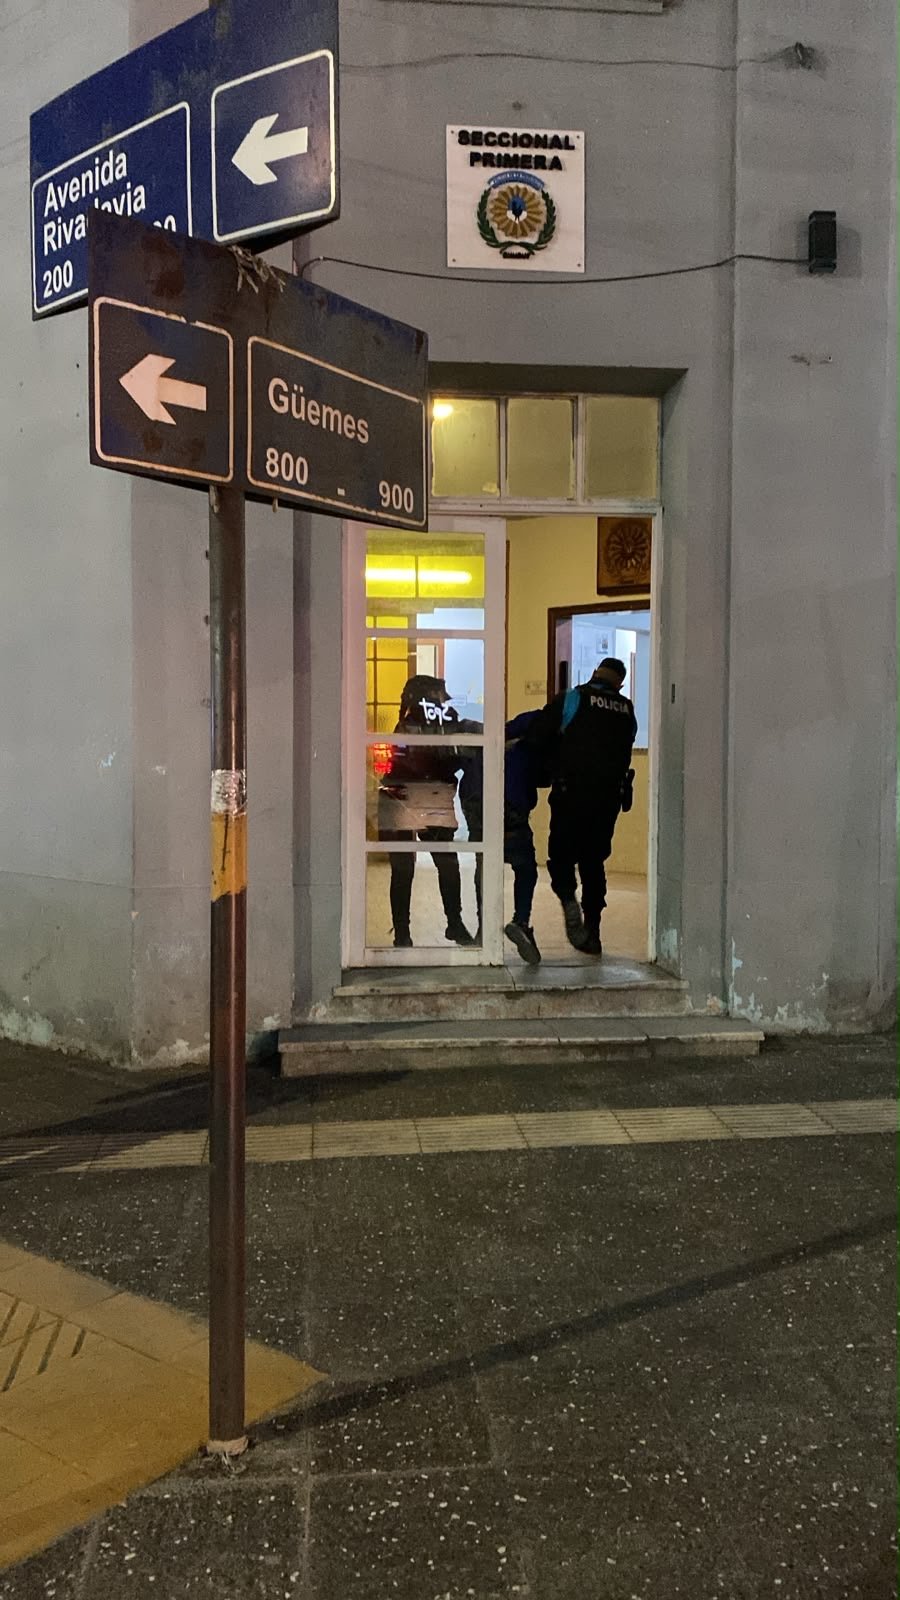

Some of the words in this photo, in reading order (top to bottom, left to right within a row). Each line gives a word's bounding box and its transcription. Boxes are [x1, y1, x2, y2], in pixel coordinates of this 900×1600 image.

[457, 129, 576, 150] SECCIONAL
[469, 151, 563, 171] PRIMERA
[44, 149, 127, 217] Avenida
[43, 260, 73, 298] 200
[268, 377, 369, 444] Güemes
[265, 447, 309, 486] 800
[378, 480, 414, 513] 900
